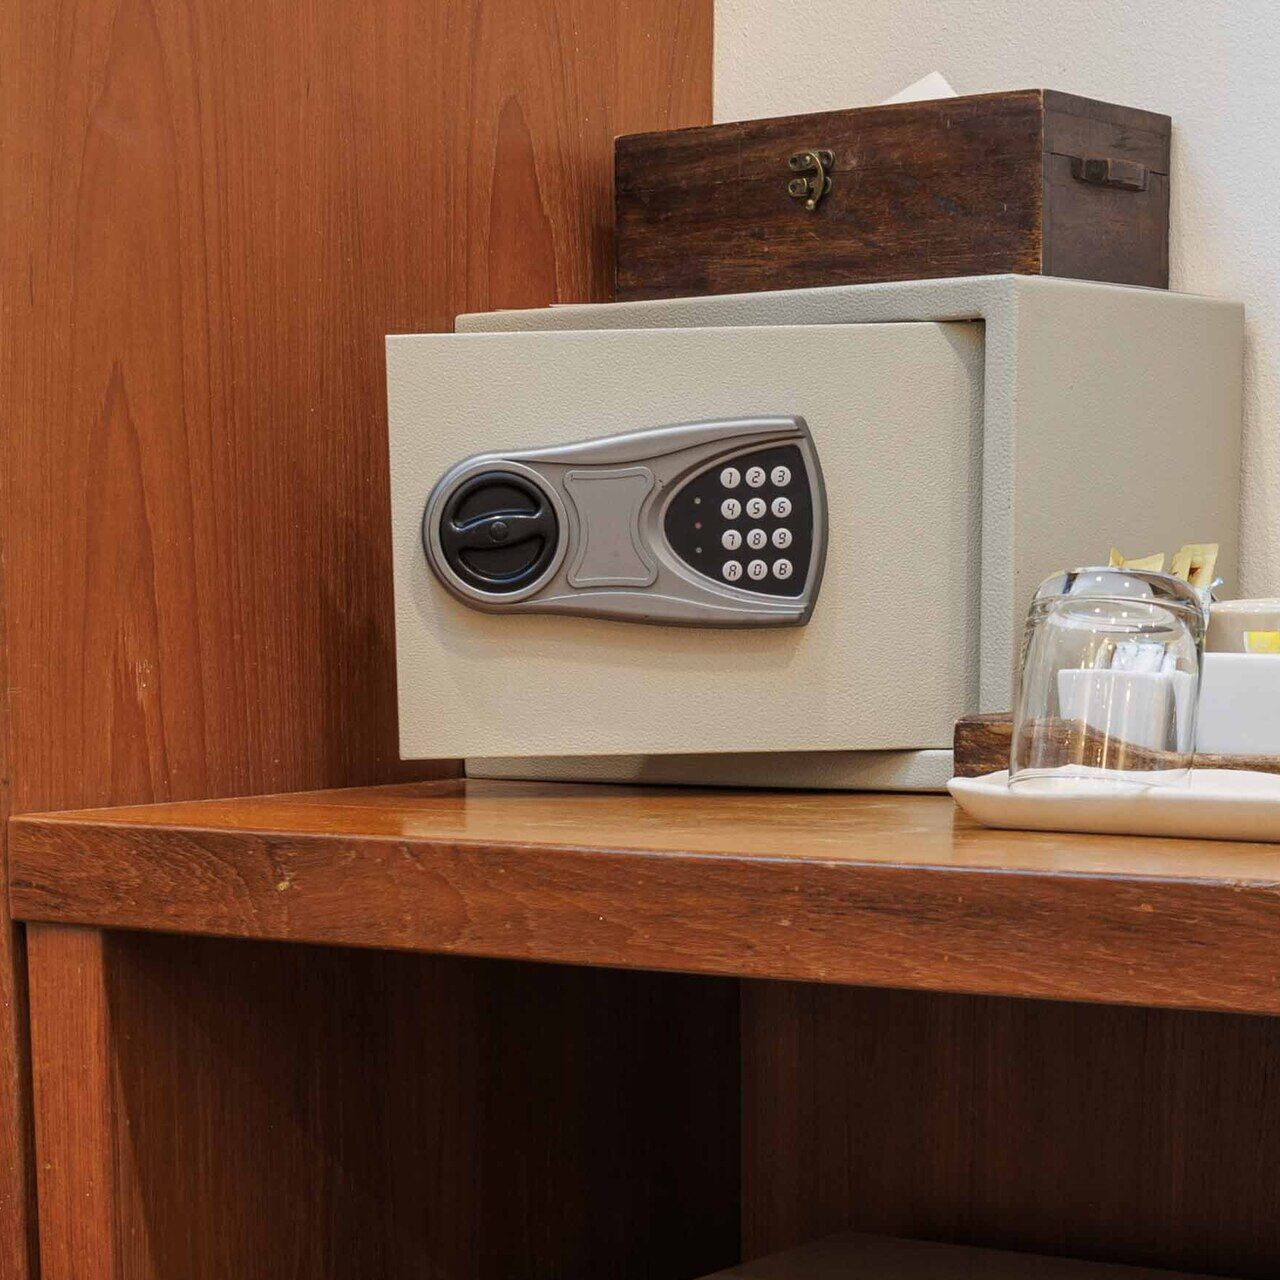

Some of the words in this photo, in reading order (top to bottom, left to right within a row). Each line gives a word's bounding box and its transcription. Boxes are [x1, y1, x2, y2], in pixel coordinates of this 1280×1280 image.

[729, 472, 732, 484] 1
[752, 471, 760, 483] 2
[778, 470, 785, 482] 3
[728, 503, 734, 515] 4
[753, 502, 760, 514] 5
[778, 502, 785, 513] 6
[729, 534, 735, 546] 7
[753, 533, 761, 545] 8
[779, 532, 786, 544] 9
[754, 564, 762, 575] 0
